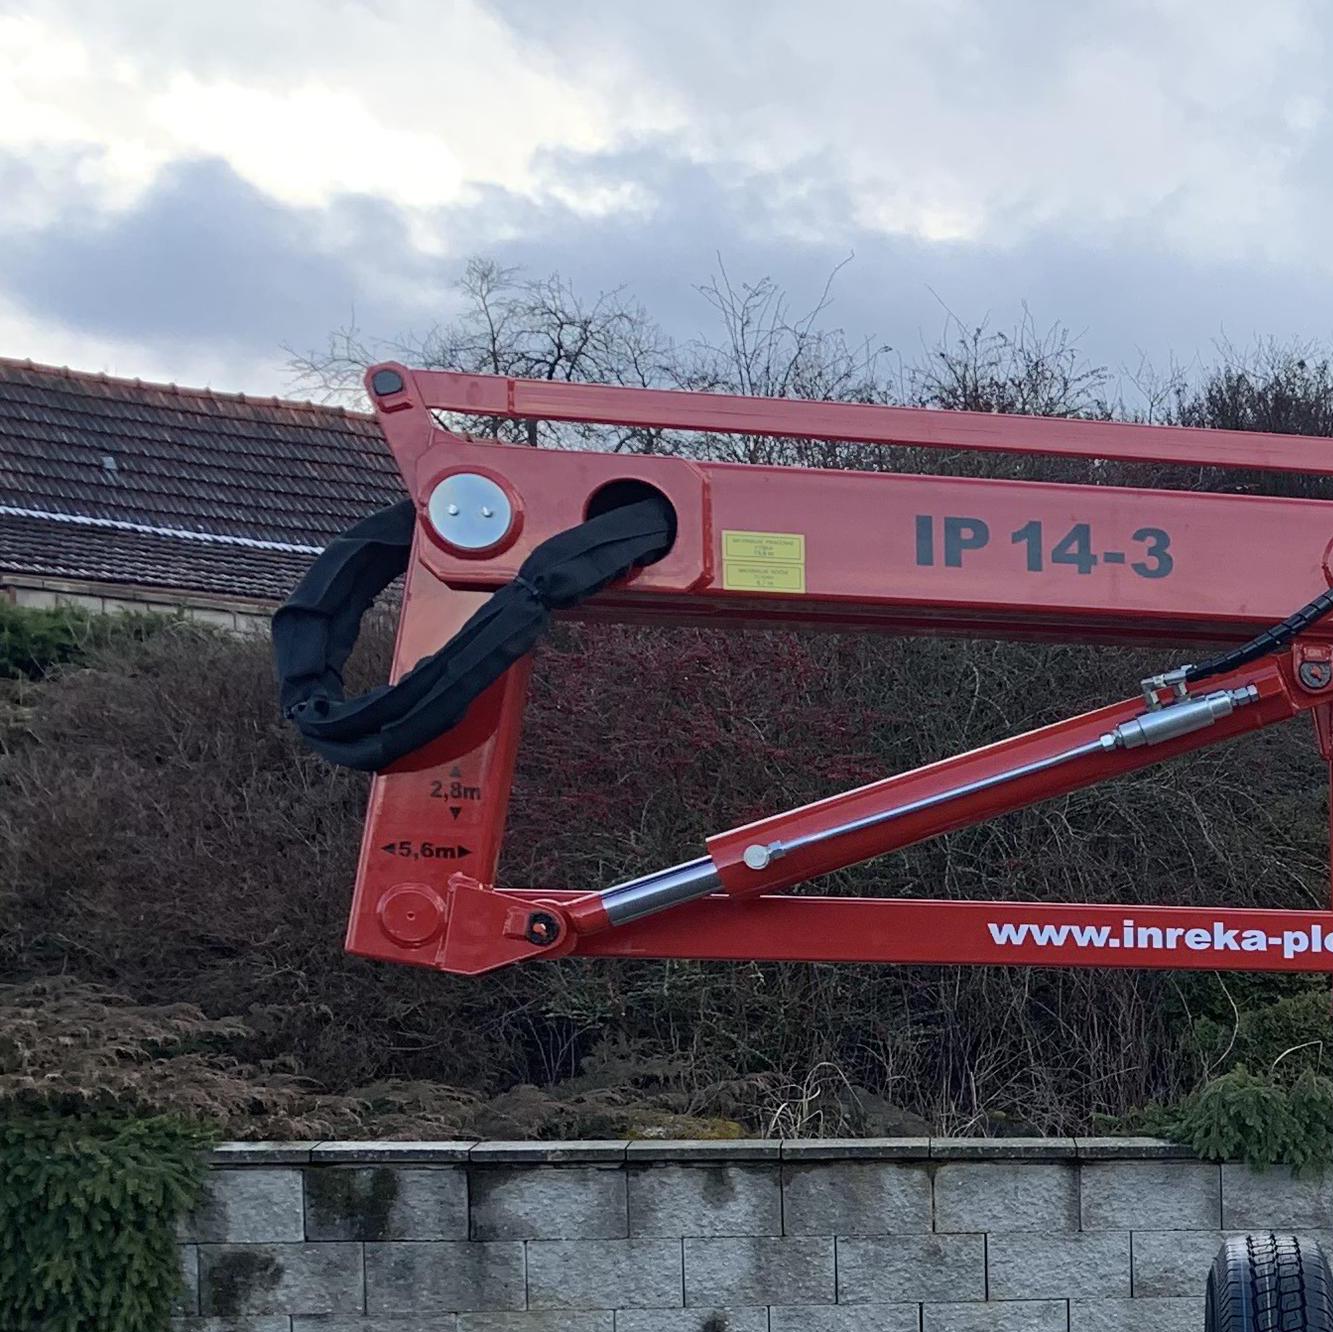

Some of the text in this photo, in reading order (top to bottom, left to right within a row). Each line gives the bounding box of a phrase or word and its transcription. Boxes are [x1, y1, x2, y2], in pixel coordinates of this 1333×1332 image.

[915, 514, 1174, 579] IP 14-3
[430, 780, 481, 802] 2,8m
[398, 841, 457, 861] 5,6m
